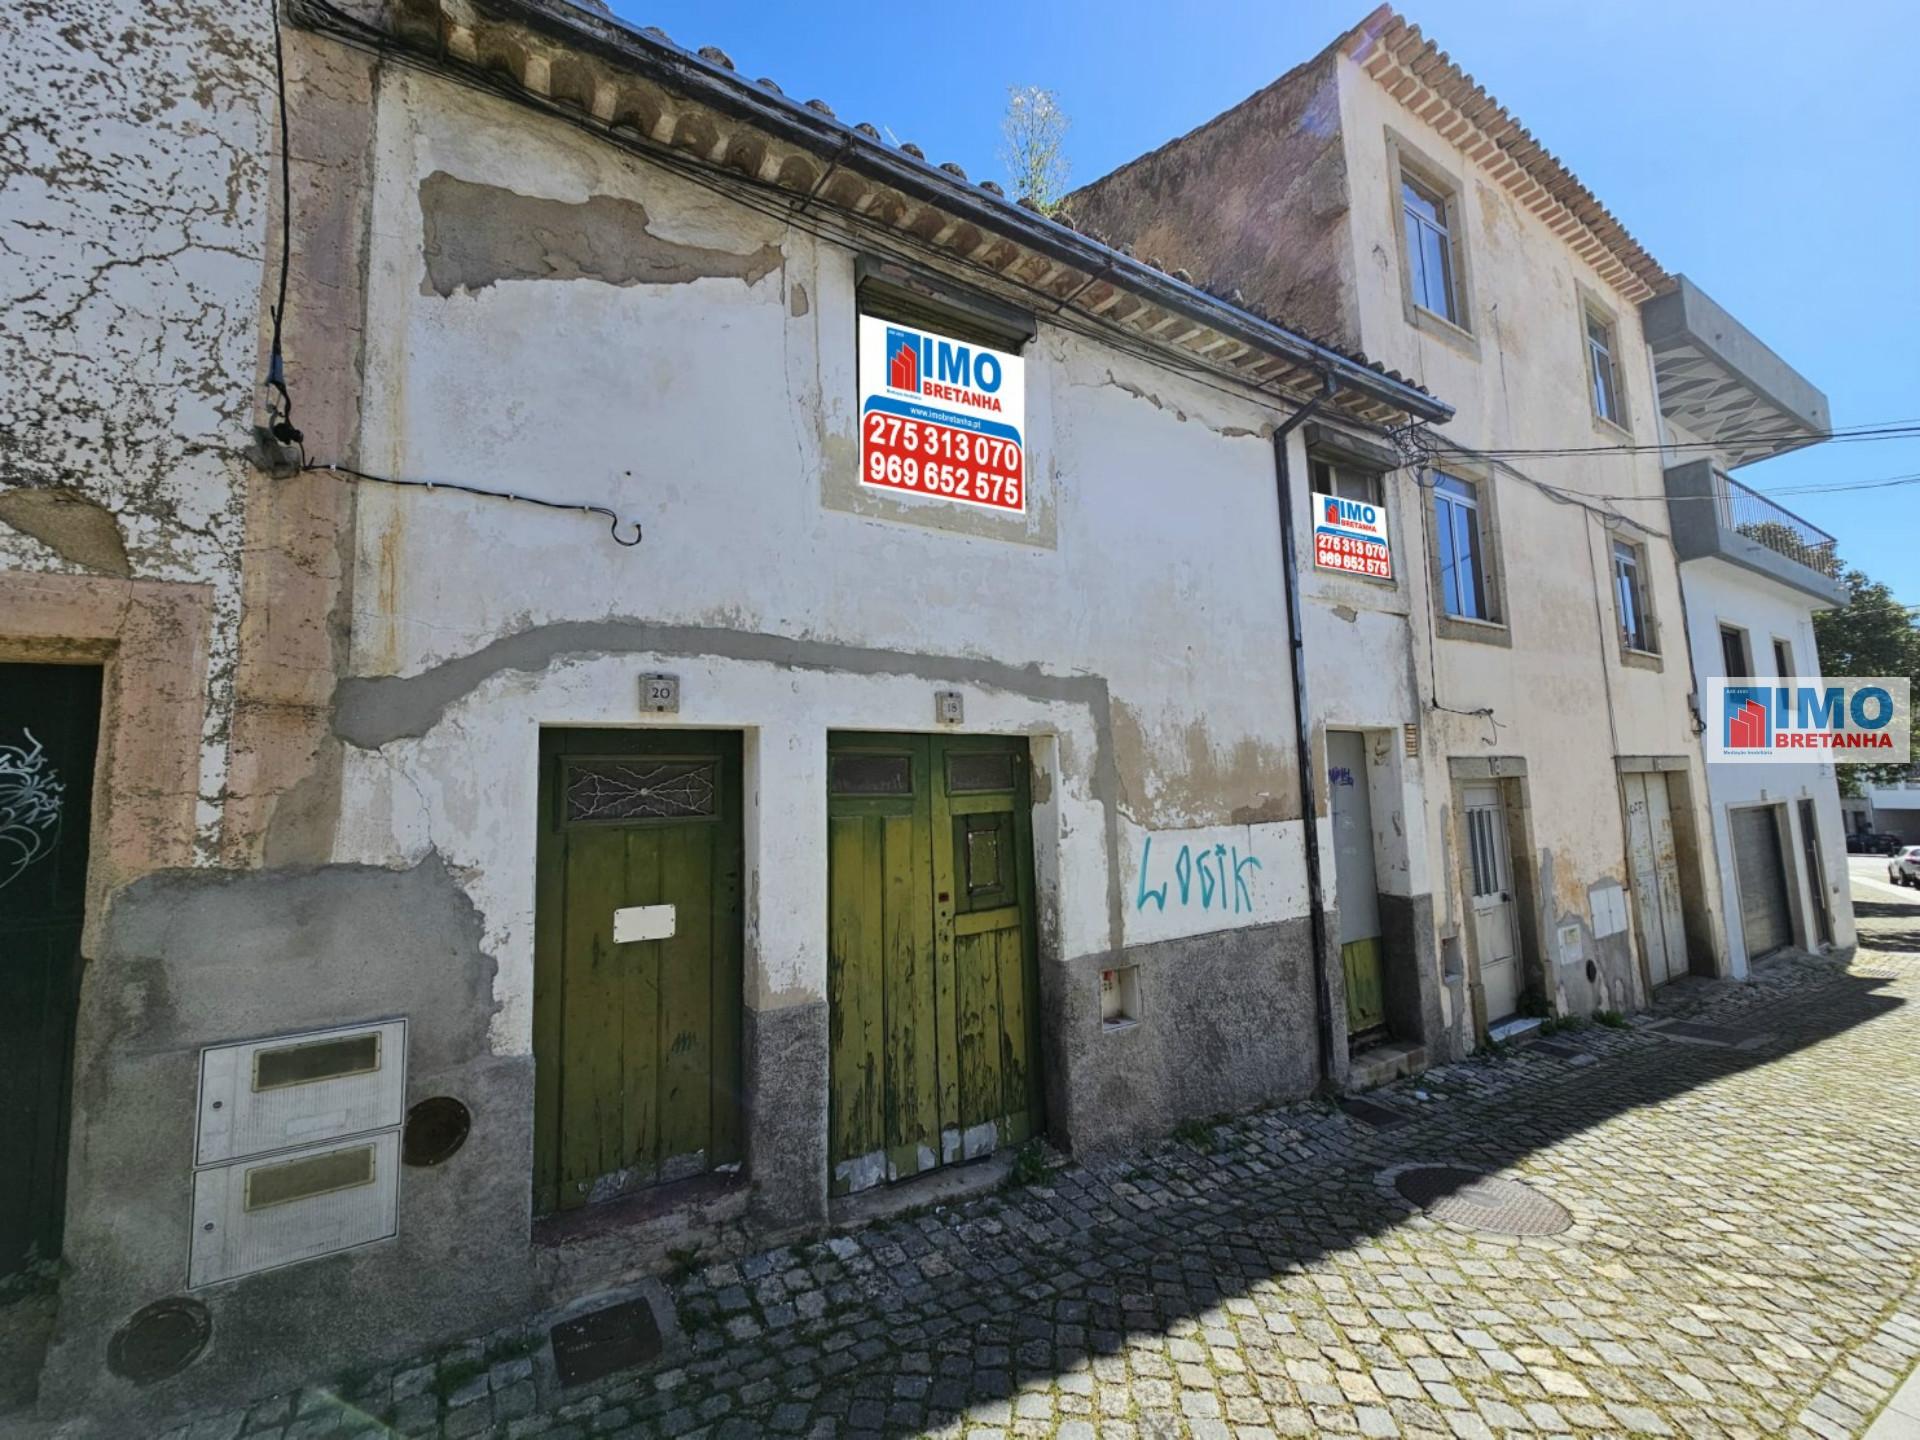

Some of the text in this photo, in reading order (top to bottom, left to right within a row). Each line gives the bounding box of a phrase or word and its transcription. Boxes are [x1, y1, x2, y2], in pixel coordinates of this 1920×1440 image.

[923, 337, 1002, 393] IMO
[923, 381, 1002, 412] BRETANHA
[910, 406, 981, 430] www.imobretanha.pt
[870, 415, 1018, 471] 275 313 070
[870, 452, 1018, 505] 969 652 575
[1341, 501, 1375, 524] IMO
[1341, 519, 1376, 532] BRETANHA
[1343, 540, 1363, 555] 313
[1366, 543, 1386, 559] 070
[652, 687, 670, 699] 20
